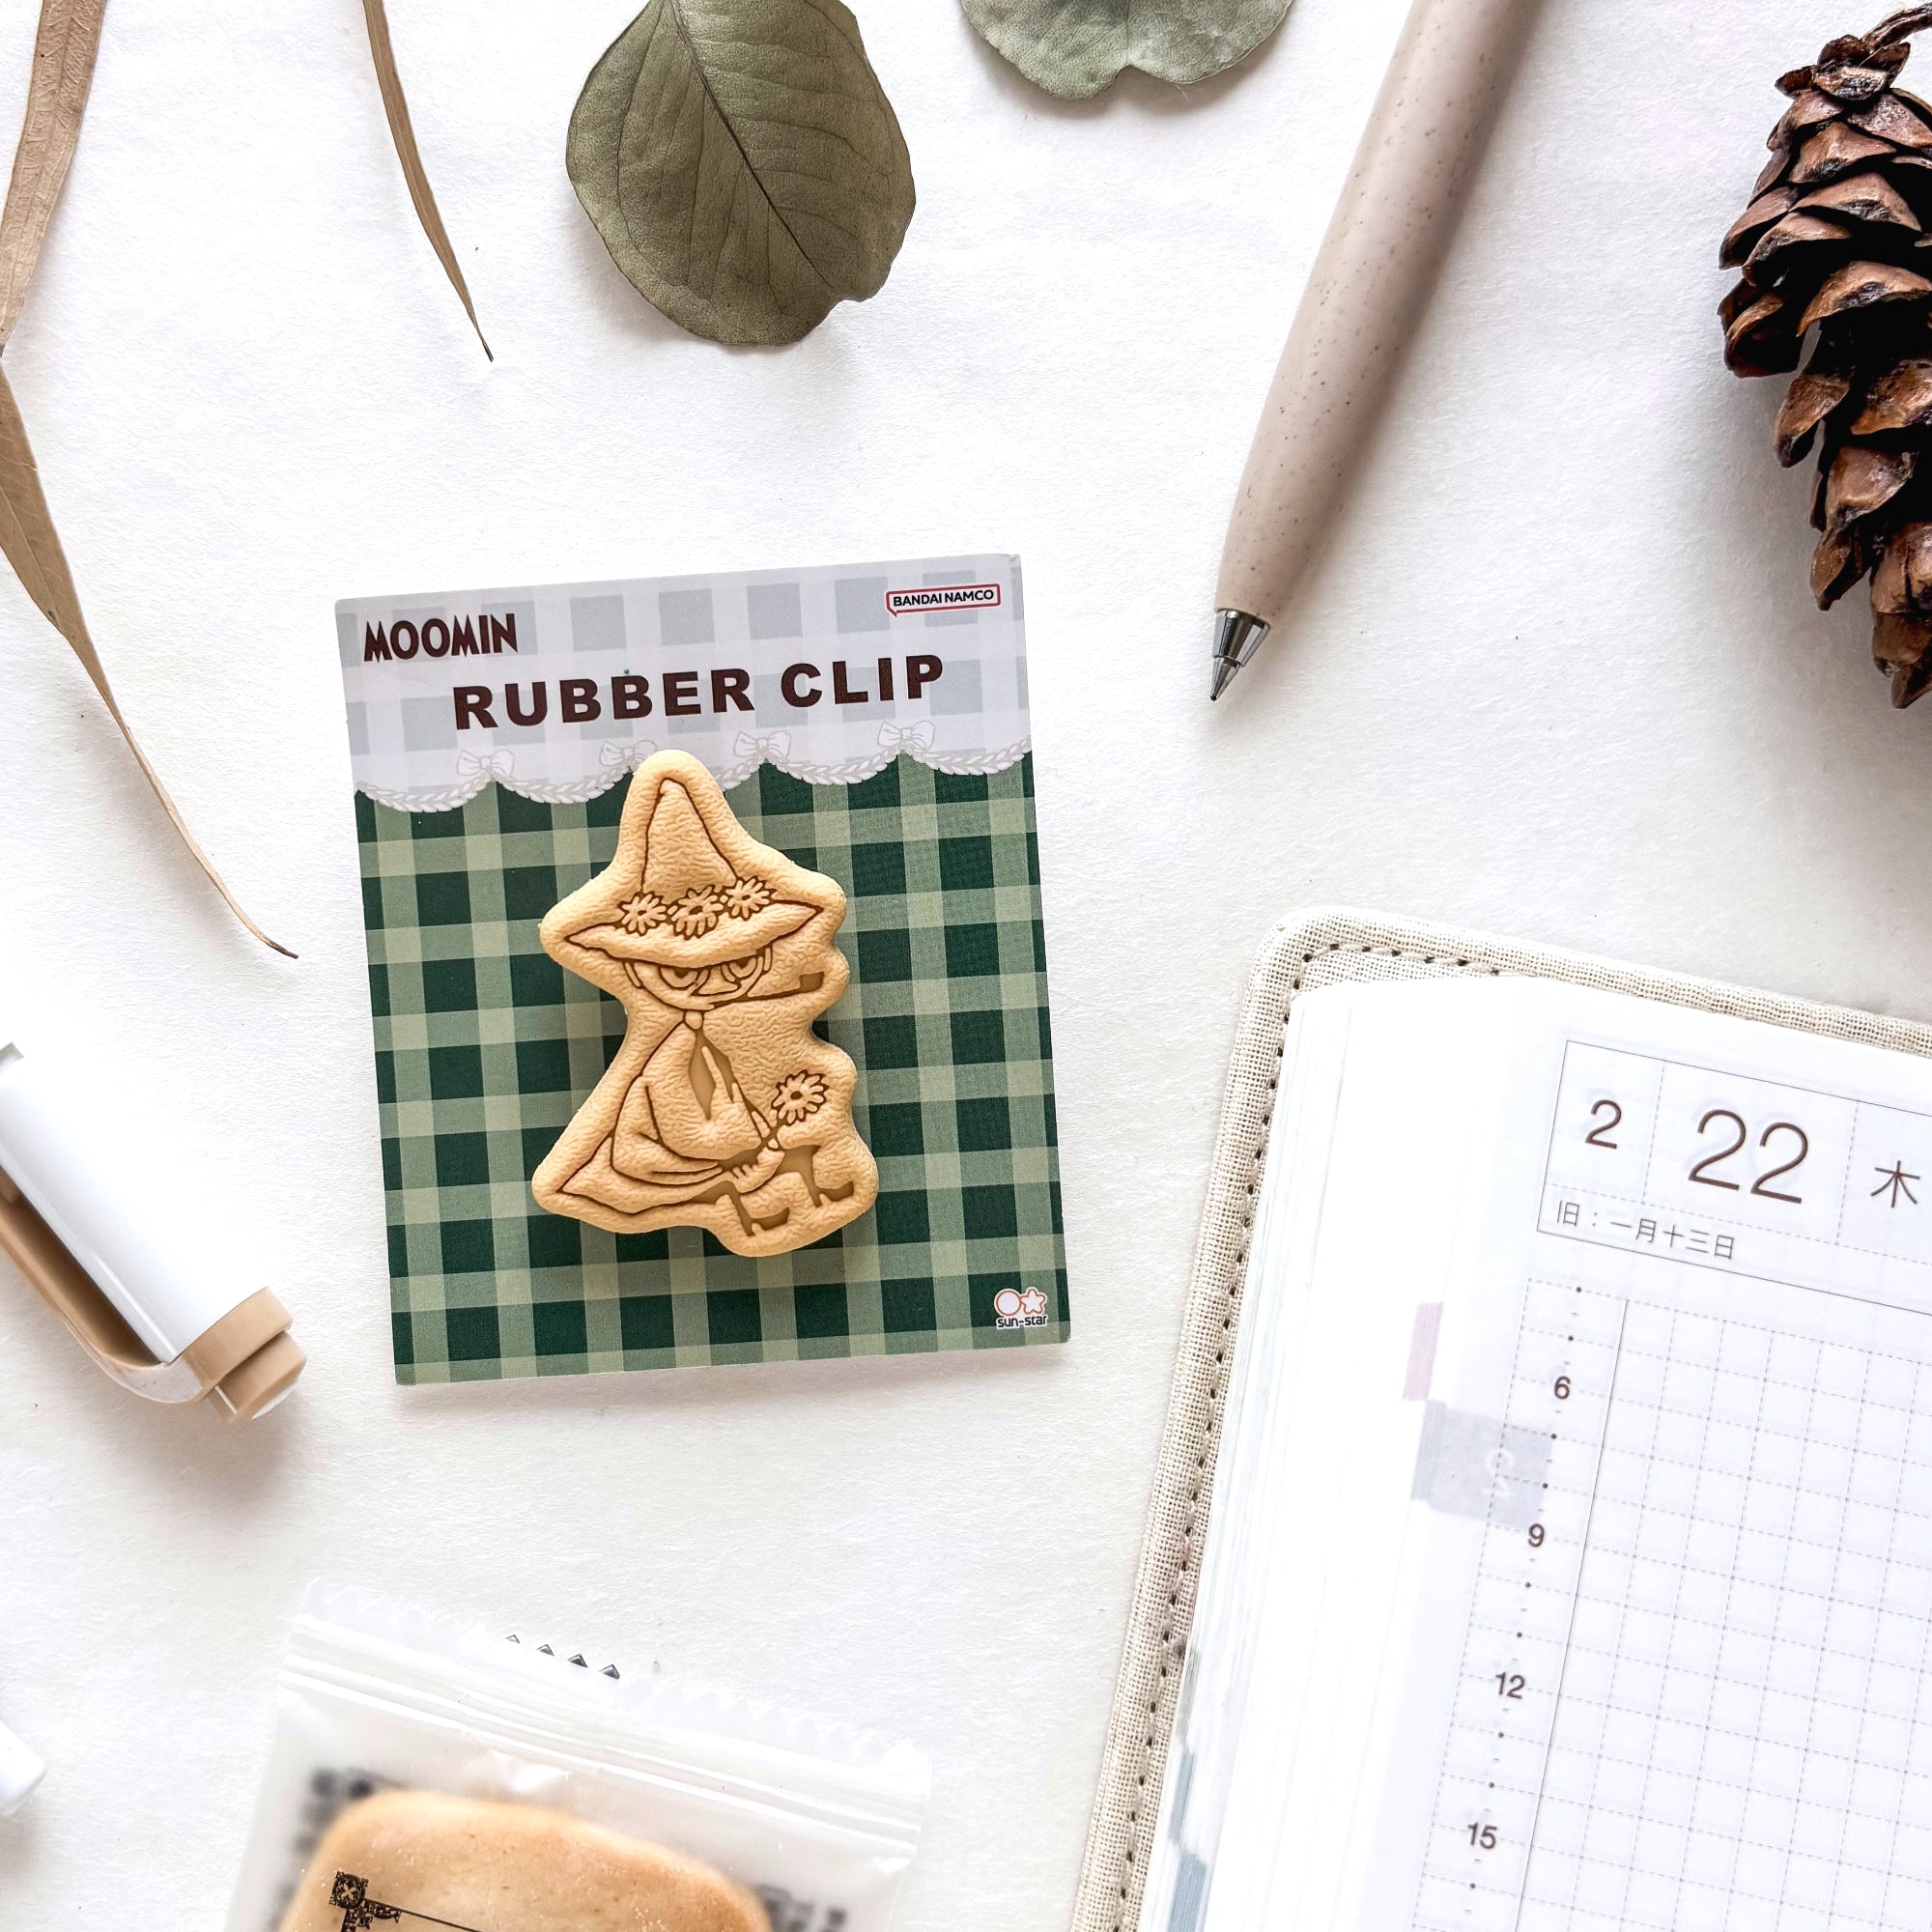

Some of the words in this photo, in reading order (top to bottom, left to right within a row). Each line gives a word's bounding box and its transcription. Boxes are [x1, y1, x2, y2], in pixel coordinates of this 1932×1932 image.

[894, 593, 942, 607] BANDAI
[945, 589, 994, 603] NAMCO
[364, 612, 518, 663] MOOMIN
[454, 668, 754, 730] RUBBER
[781, 654, 944, 708] CLIP
[1584, 1099, 1622, 1150] 2
[1688, 1109, 1808, 1204] 22
[1870, 1159, 1920, 1208] 木
[997, 1315, 1047, 1328] sun-star
[1553, 1376, 1572, 1400] 6
[1527, 1523, 1546, 1548] 9
[1495, 1671, 1526, 1699] 12
[1466, 1822, 1497, 1850] 15
